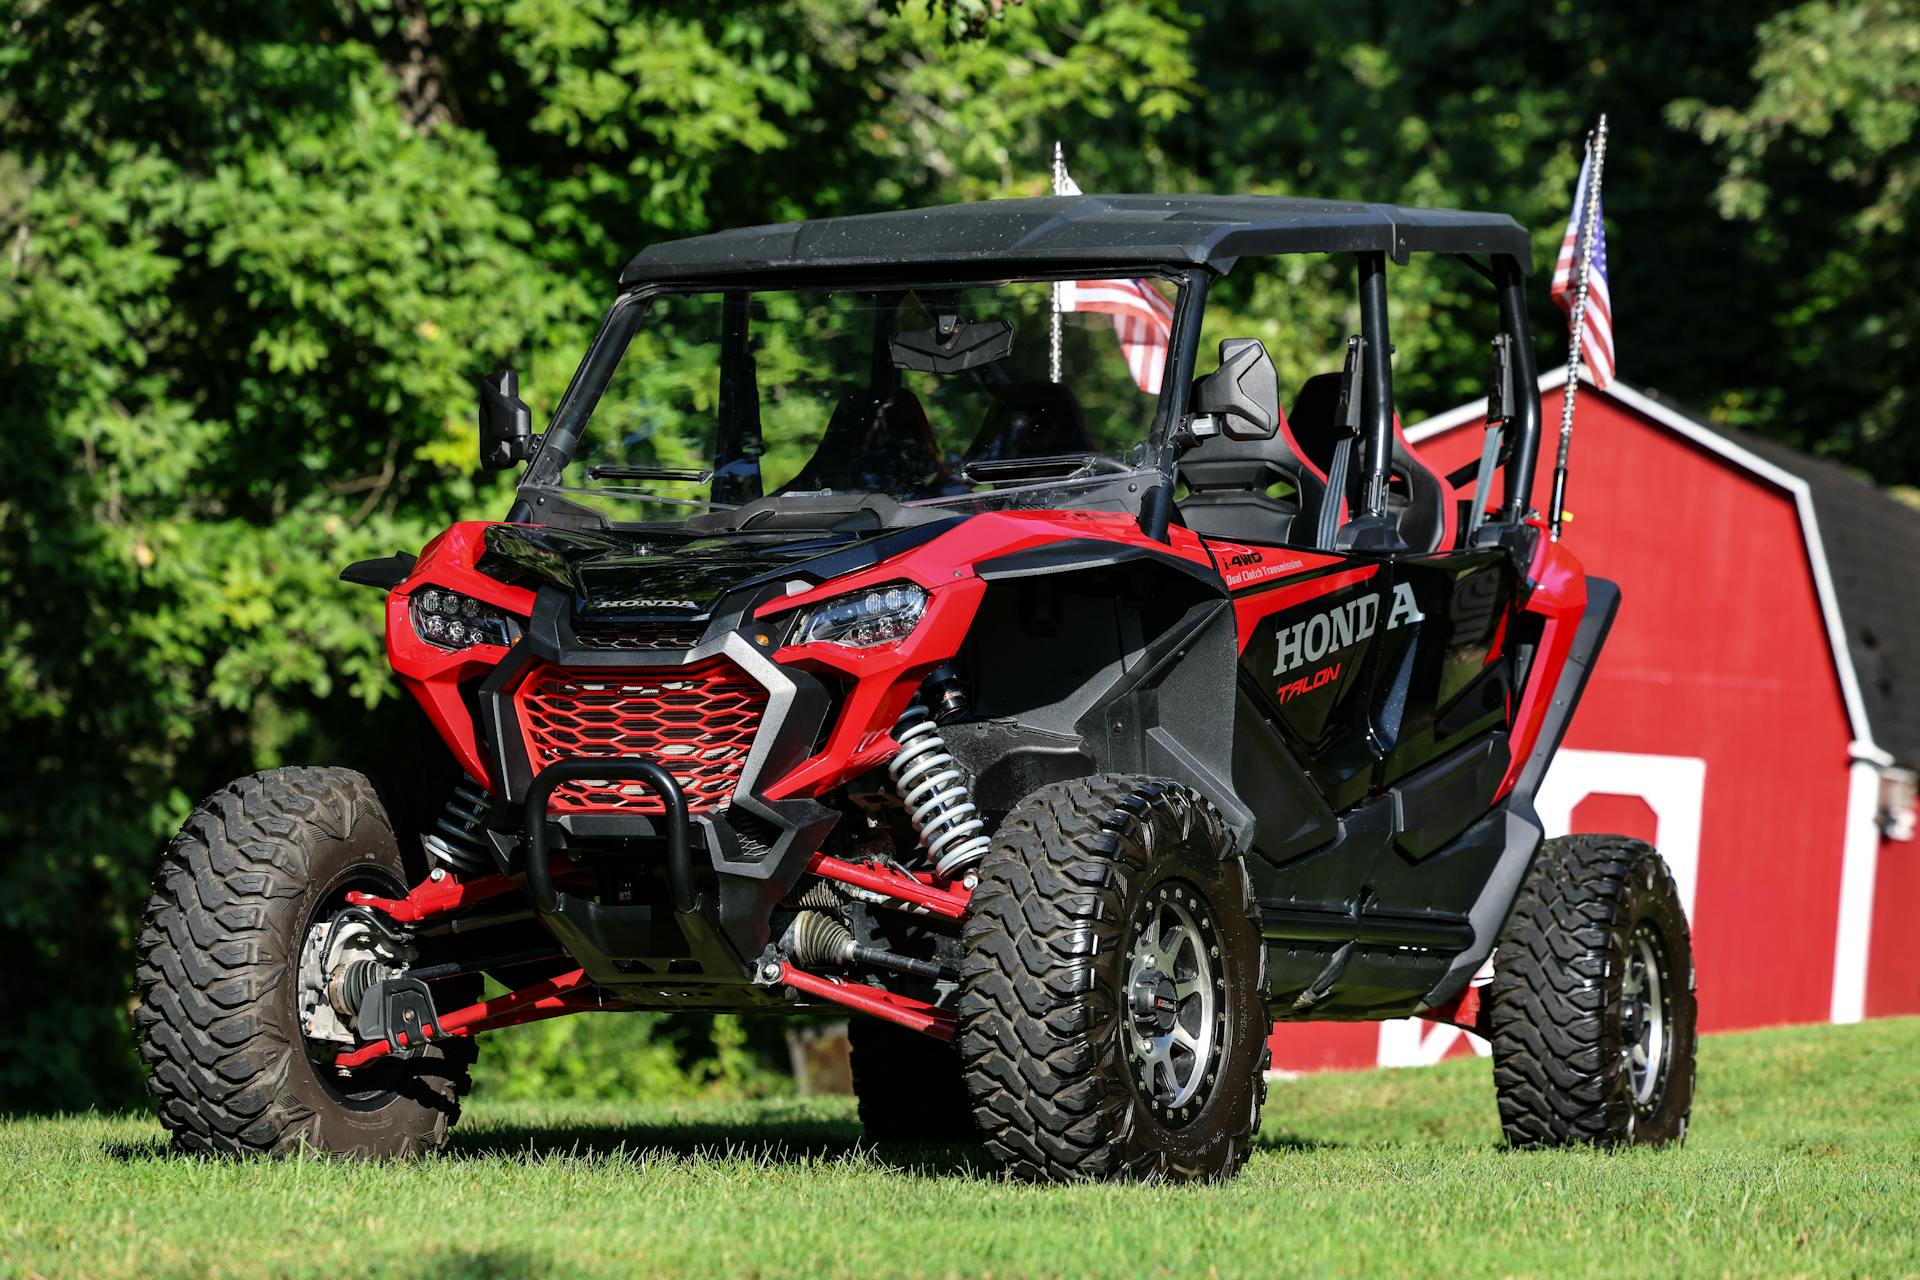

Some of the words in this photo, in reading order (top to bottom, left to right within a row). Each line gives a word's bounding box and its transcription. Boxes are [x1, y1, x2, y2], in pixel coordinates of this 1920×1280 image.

[1226, 572, 1242, 586] Dual
[1242, 567, 1263, 582] Clutch
[1262, 559, 1304, 576] Transmission
[598, 600, 699, 608] HONDA
[1273, 582, 1425, 676] HONDA
[1276, 662, 1342, 705] TALON
